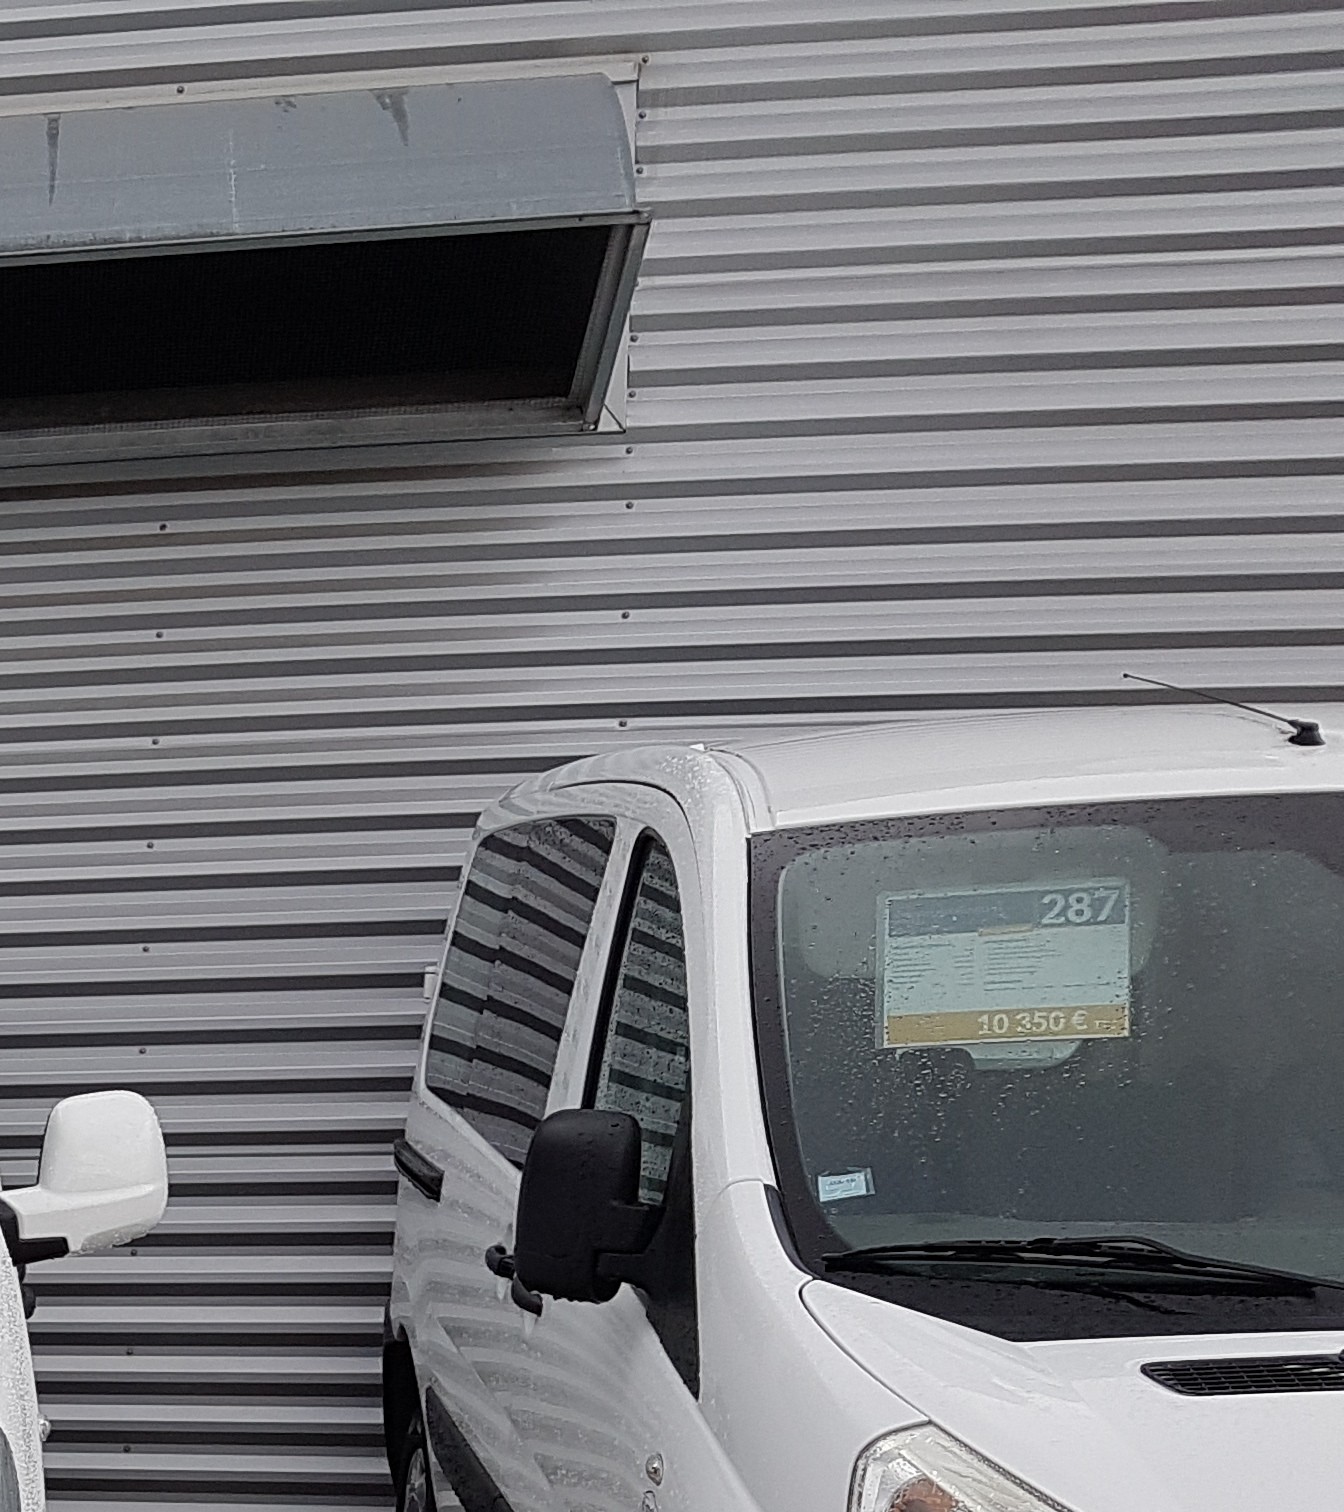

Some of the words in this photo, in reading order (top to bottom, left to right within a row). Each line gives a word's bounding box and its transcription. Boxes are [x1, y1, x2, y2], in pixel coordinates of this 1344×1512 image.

[1040, 888, 1121, 926] 287
[977, 1012, 1010, 1035] 10
[1015, 1010, 1066, 1034] 350
[1072, 1009, 1089, 1031] €
